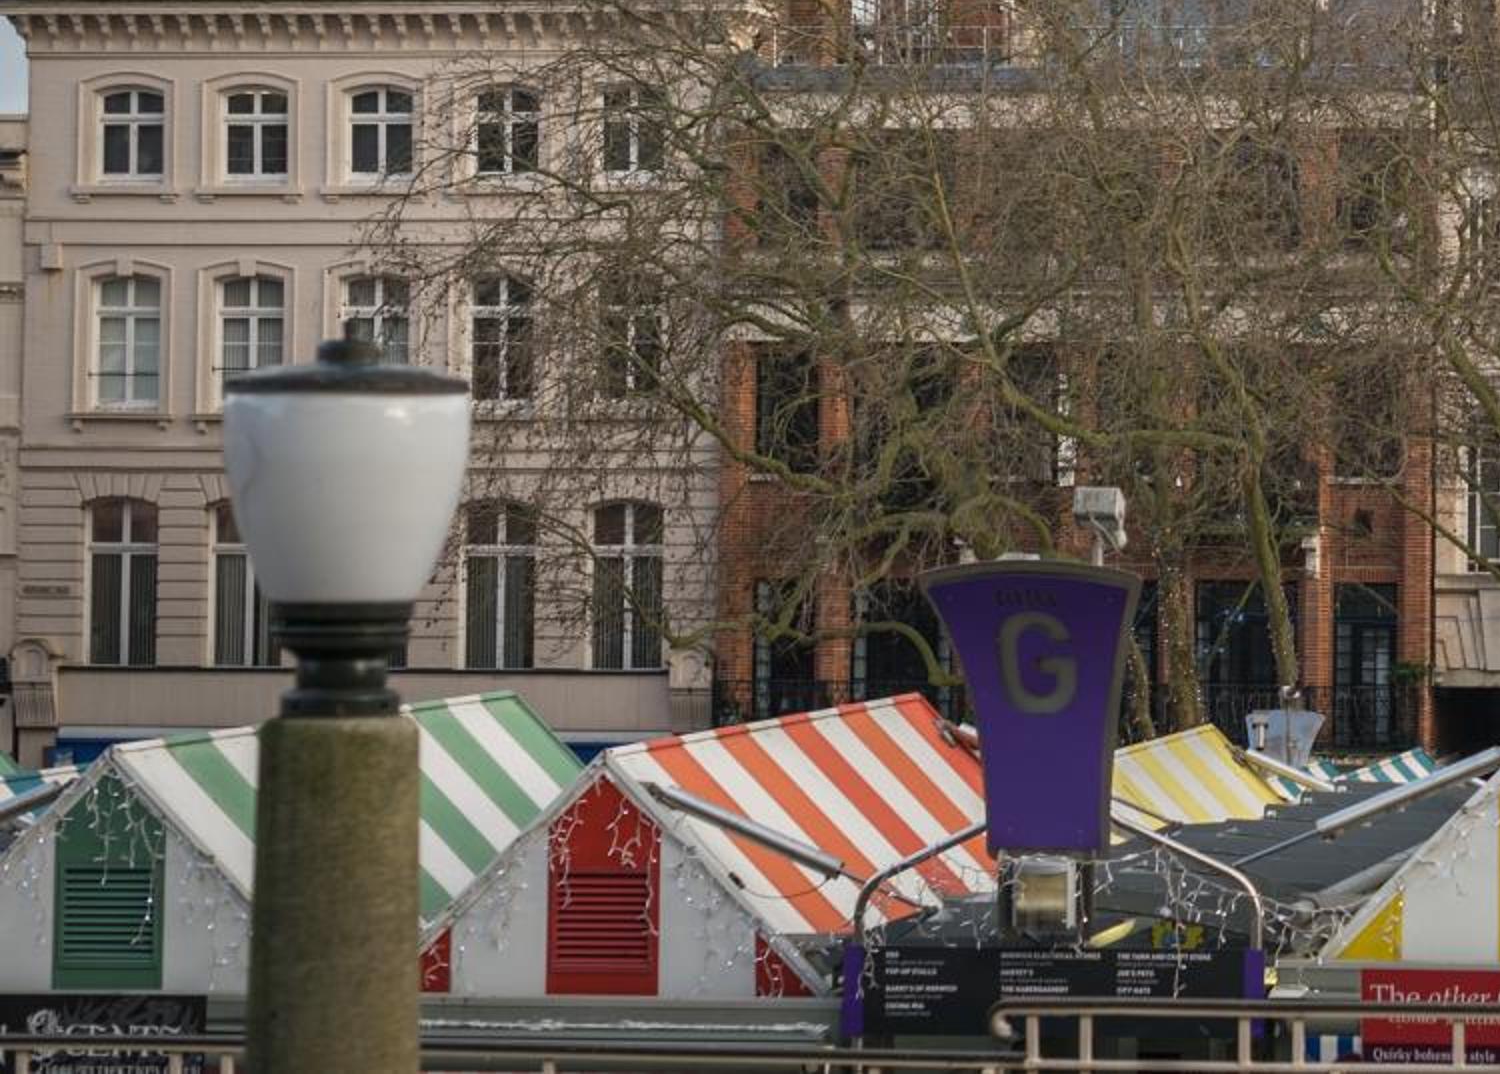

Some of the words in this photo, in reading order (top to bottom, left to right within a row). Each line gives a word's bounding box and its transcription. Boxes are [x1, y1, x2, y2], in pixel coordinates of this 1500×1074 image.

[1000, 611, 1079, 714] G
[1369, 982, 1421, 1005] The
[1427, 984, 1491, 1006] other
[1373, 1047, 1412, 1063] Quirky
[1469, 1048, 1496, 1063] style
